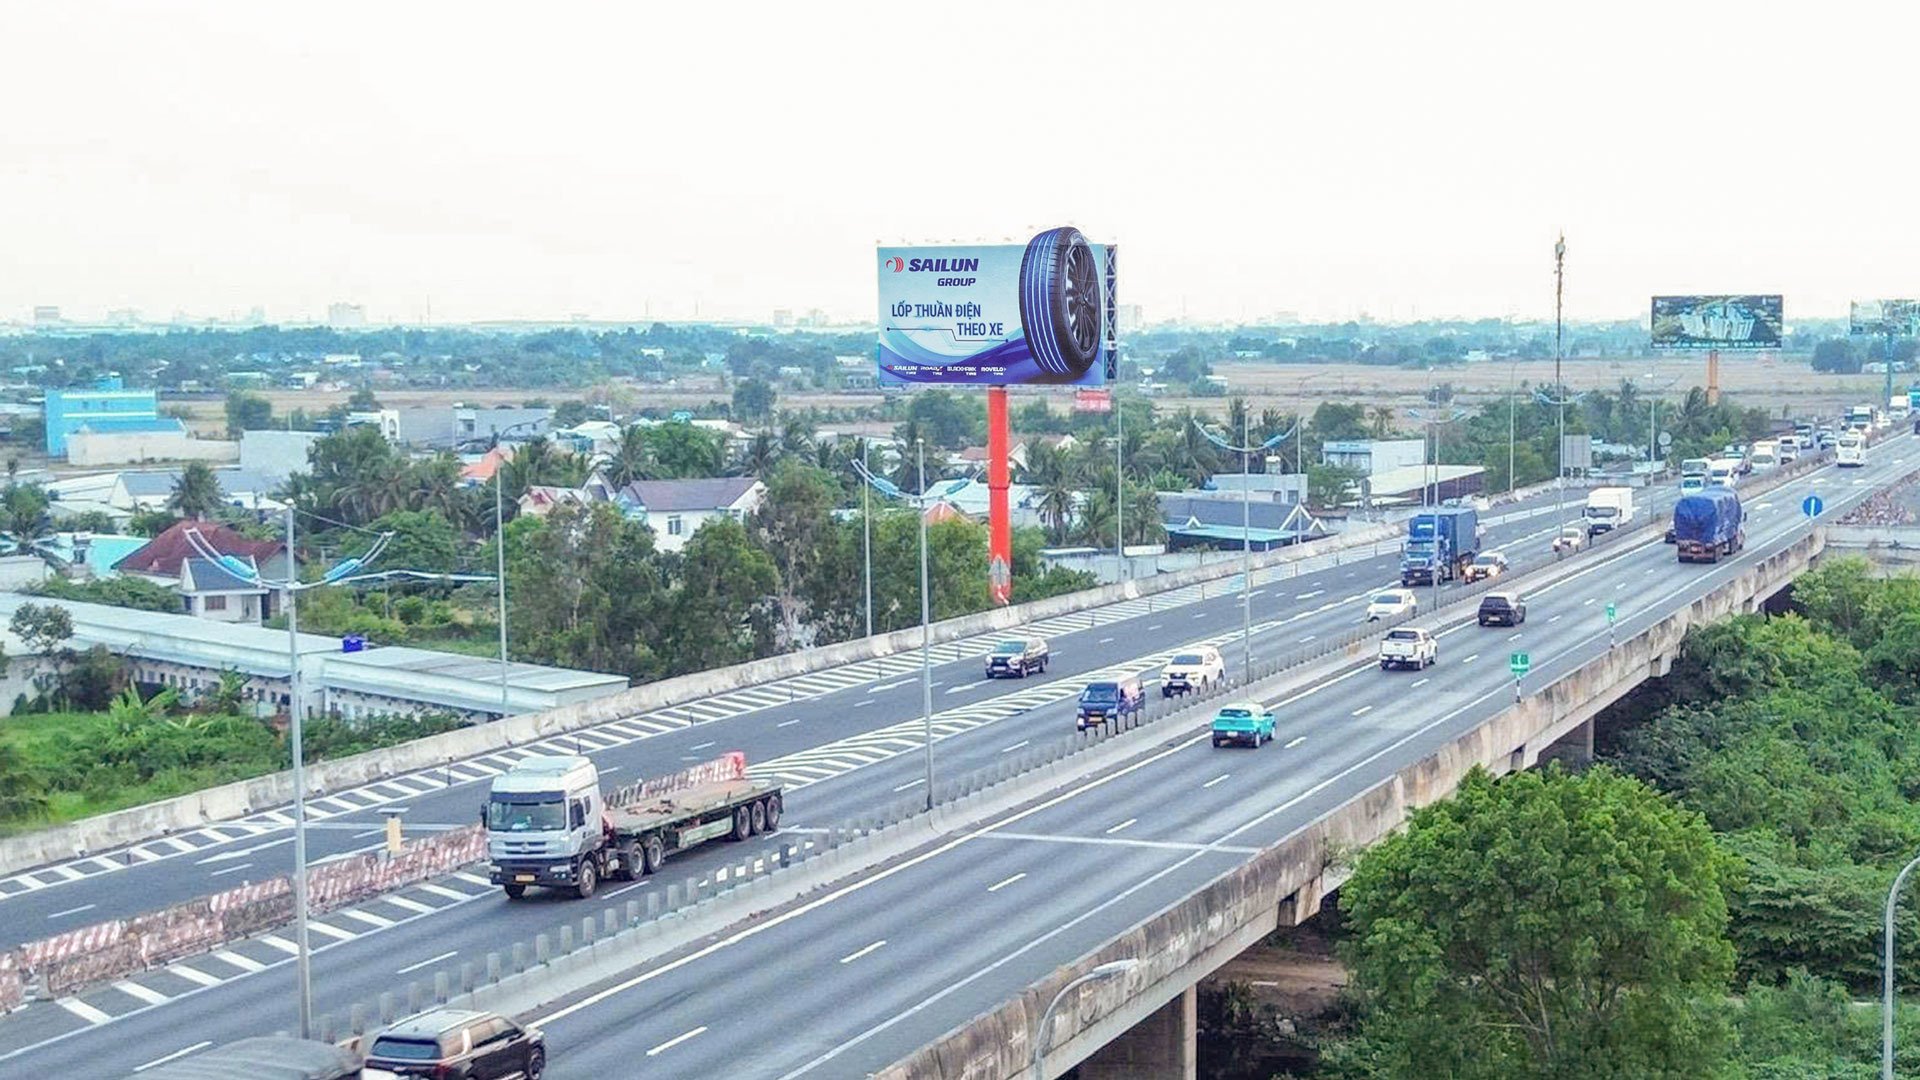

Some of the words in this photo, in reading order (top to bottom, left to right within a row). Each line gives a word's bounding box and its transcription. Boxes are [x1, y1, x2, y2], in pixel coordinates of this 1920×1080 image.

[909, 258, 979, 272] SAILUN
[937, 278, 976, 287] GROUP
[892, 300, 912, 317] LỐP
[915, 300, 953, 317] THUẦN
[955, 301, 981, 320] ĐIỆN
[957, 323, 986, 336] THEO
[989, 323, 1003, 336] XE
